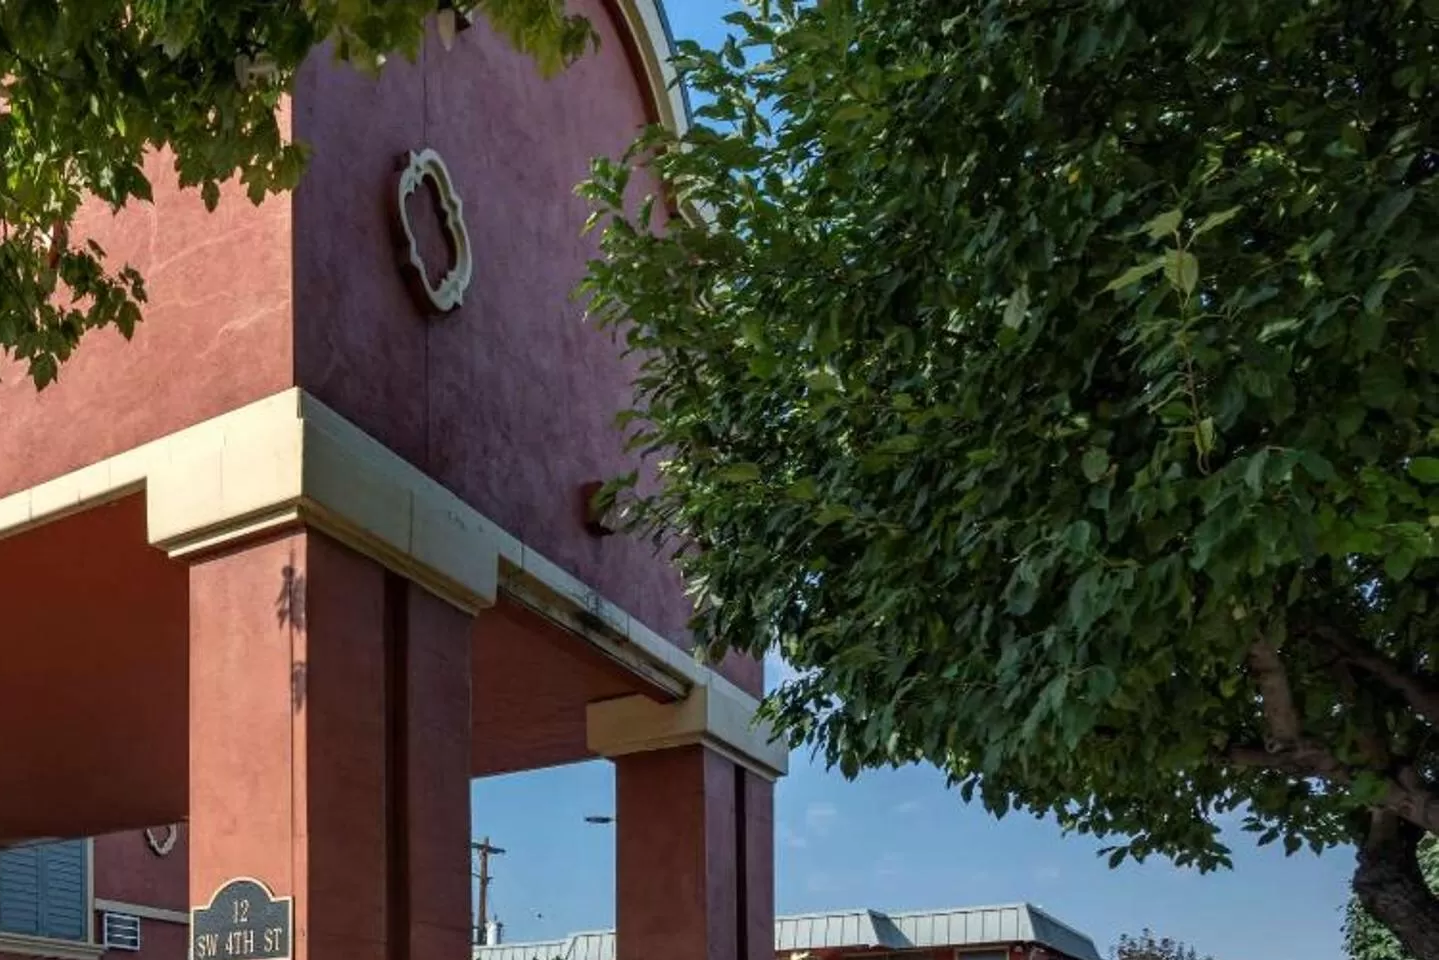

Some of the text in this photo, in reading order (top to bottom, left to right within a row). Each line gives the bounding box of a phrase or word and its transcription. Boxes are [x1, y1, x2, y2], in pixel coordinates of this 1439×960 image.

[233, 900, 250, 923] 12
[196, 927, 282, 960] SW 4TH ST
